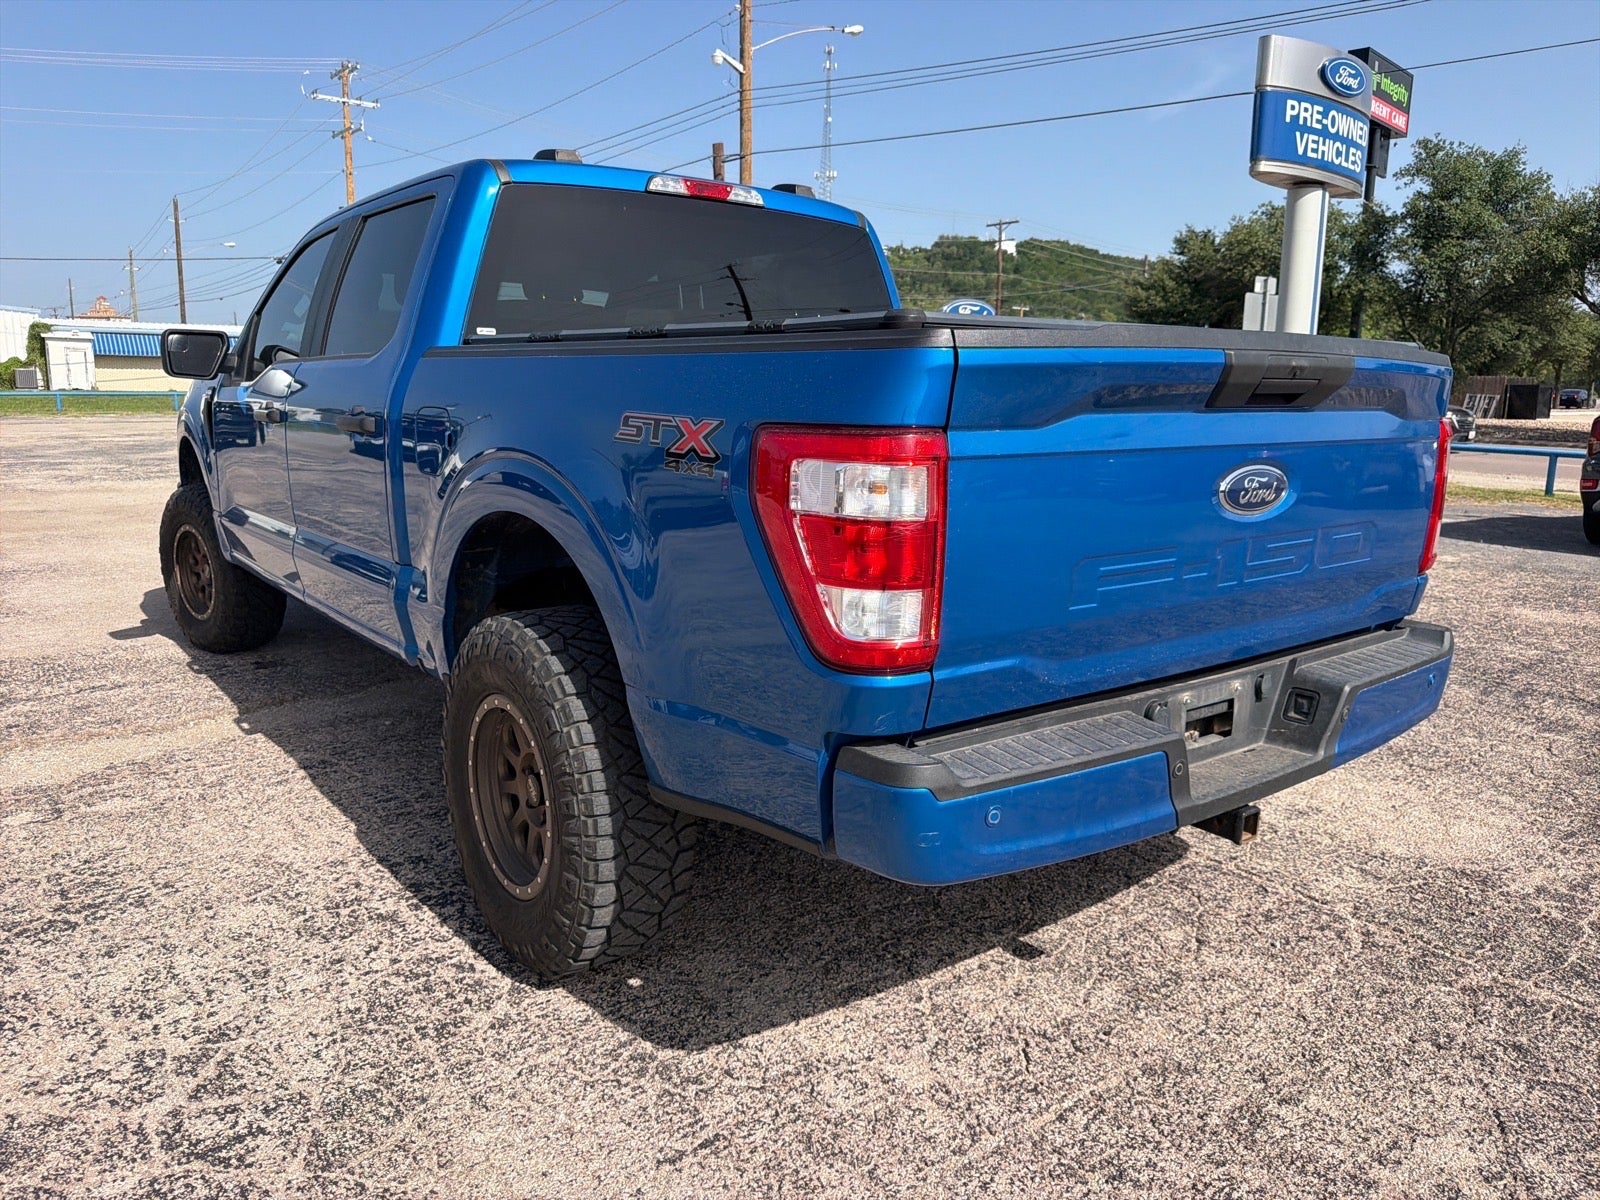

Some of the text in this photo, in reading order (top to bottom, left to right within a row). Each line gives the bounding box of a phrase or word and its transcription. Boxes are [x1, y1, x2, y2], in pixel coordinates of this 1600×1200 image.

[1335, 65, 1360, 89] Ford
[1381, 73, 1409, 107] Integrity
[1285, 99, 1368, 147] PRE-OWNED
[1371, 100, 1406, 129] RGENT CARE
[1295, 131, 1362, 173] VEHICLES
[614, 411, 725, 464] STX
[1239, 476, 1278, 504] Ford
[1069, 520, 1378, 611] F-150
